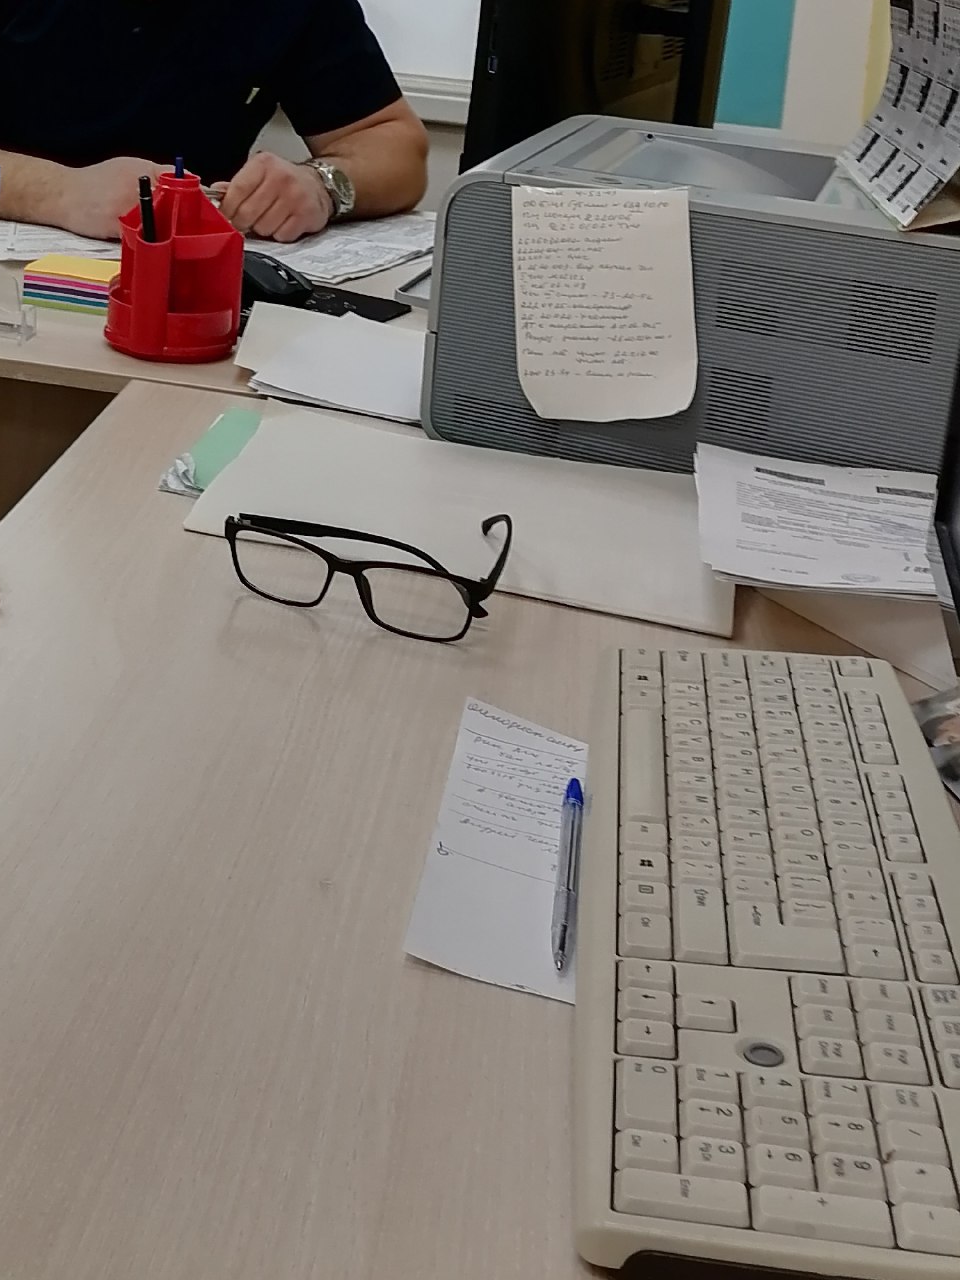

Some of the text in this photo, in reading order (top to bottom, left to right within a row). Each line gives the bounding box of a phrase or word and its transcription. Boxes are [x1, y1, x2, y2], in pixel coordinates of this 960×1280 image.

[694, 775, 707, 783] N
[791, 785, 805, 793] U
[746, 808, 761, 816] K
[800, 828, 814, 837] O
[804, 853, 819, 861] P
[651, 1065, 667, 1073] 0
[777, 1078, 793, 1087] 4
[841, 1084, 858, 1093] 7
[715, 1106, 733, 1117] 2
[780, 1115, 799, 1126] 5
[846, 1122, 865, 1131] 8
[717, 1145, 736, 1155] 3
[784, 1151, 803, 1162] 6
[853, 1160, 873, 1171] 9
[679, 1178, 691, 1199] Enter
